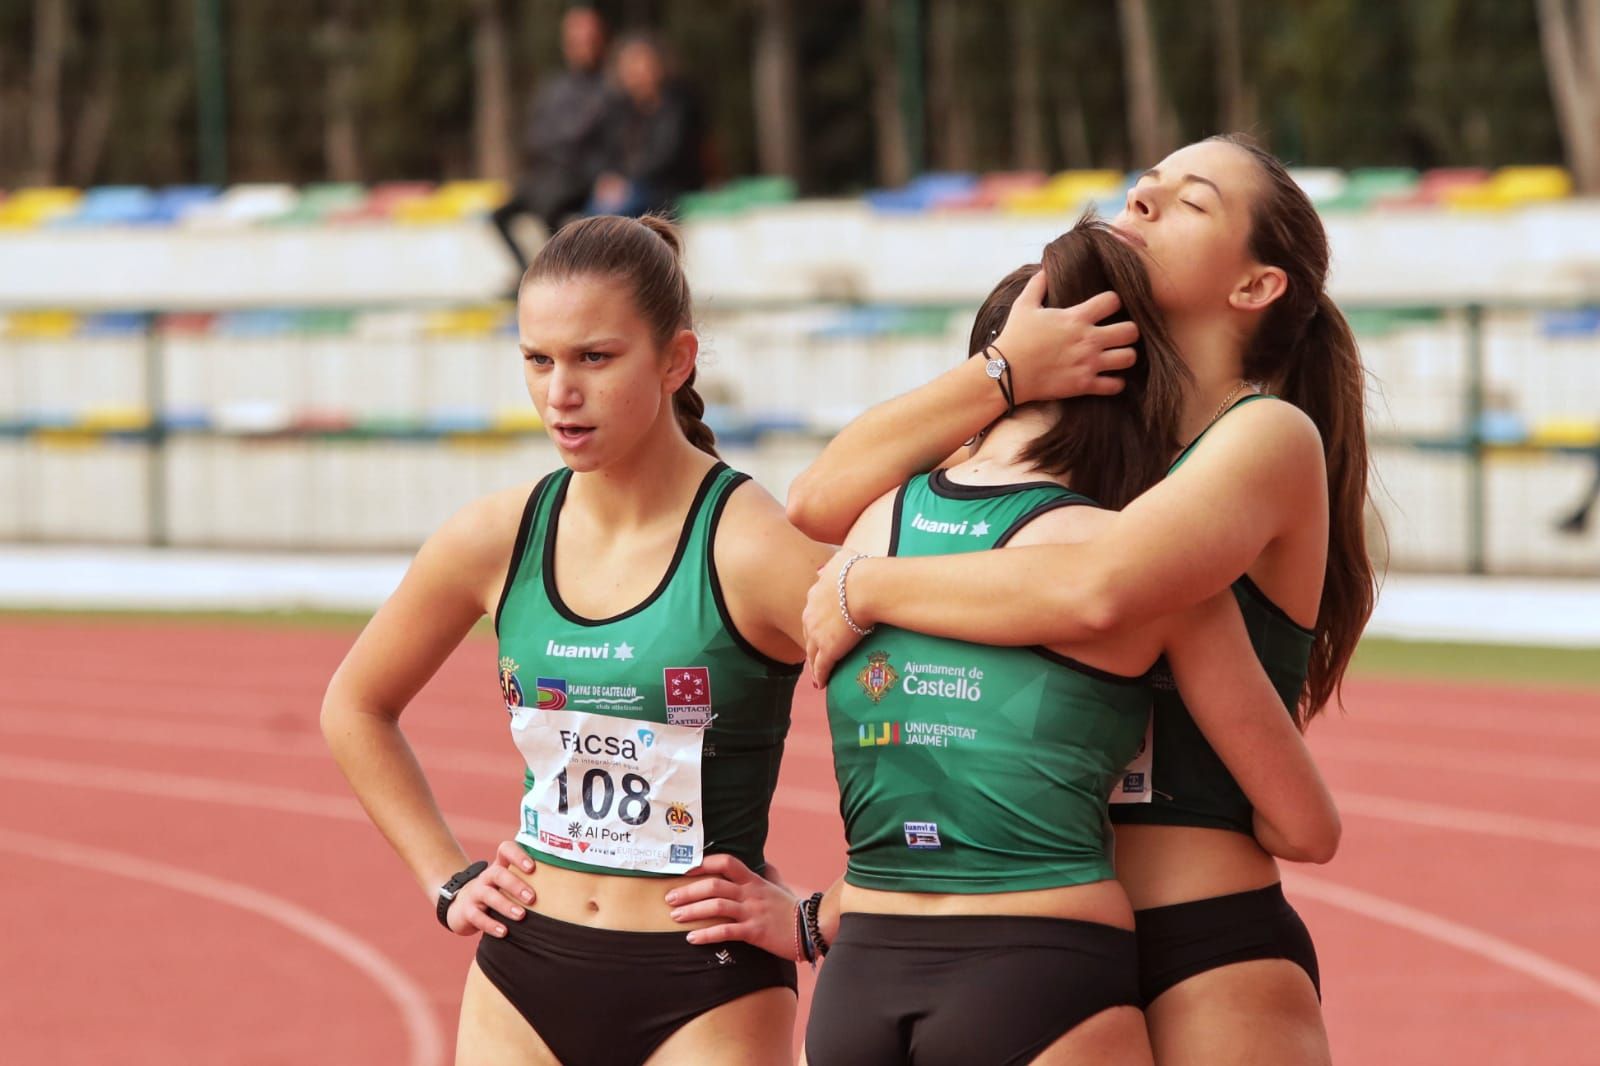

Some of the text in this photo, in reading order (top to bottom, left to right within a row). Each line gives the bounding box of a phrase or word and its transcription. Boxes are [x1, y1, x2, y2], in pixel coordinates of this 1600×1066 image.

[911, 513, 968, 535] luanvi
[546, 640, 610, 659] luanvi
[904, 662, 984, 680] Ajuntament de
[568, 685, 591, 696] PLAYAS
[592, 686, 600, 696] DE
[903, 675, 981, 701] Castelló
[905, 722, 978, 740] UNIVERSITAT
[905, 734, 942, 747] JAUME
[552, 767, 651, 826] 108
[602, 827, 631, 843] Port
